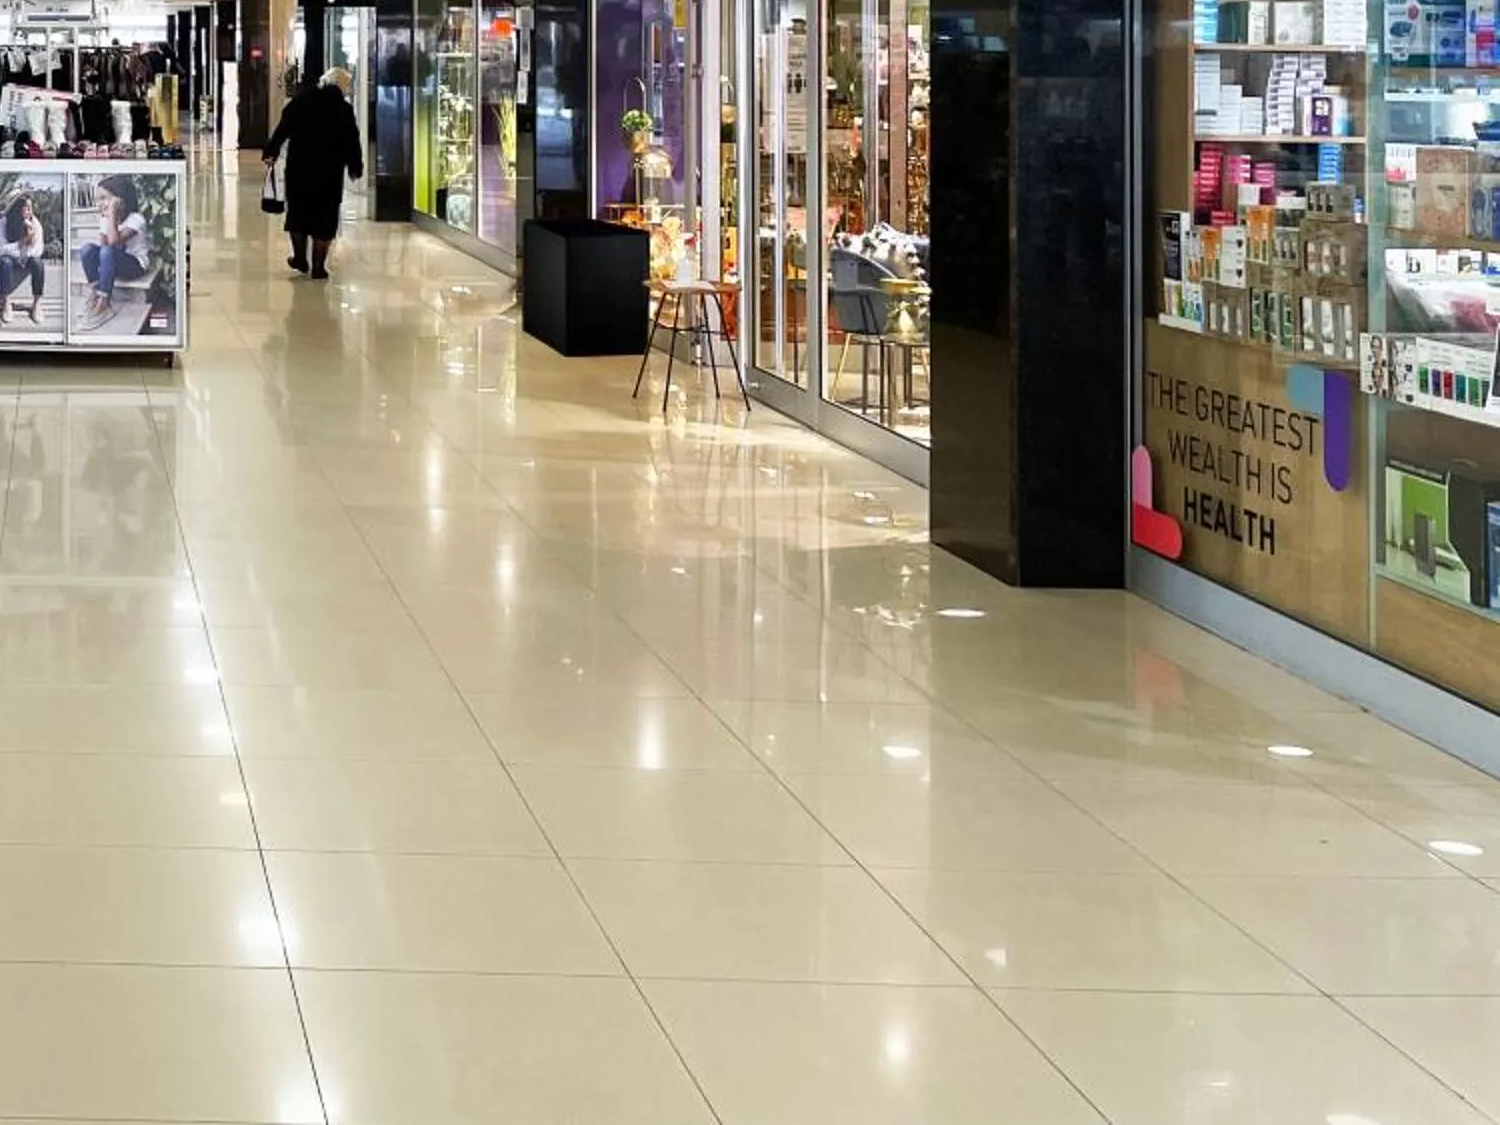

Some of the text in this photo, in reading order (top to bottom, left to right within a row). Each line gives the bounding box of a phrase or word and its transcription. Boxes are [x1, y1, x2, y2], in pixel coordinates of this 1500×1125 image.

[1147, 371, 1319, 455] THE GREATEST
[1167, 427, 1293, 504] WEALTH IS
[1183, 486, 1276, 556] HEALTH
